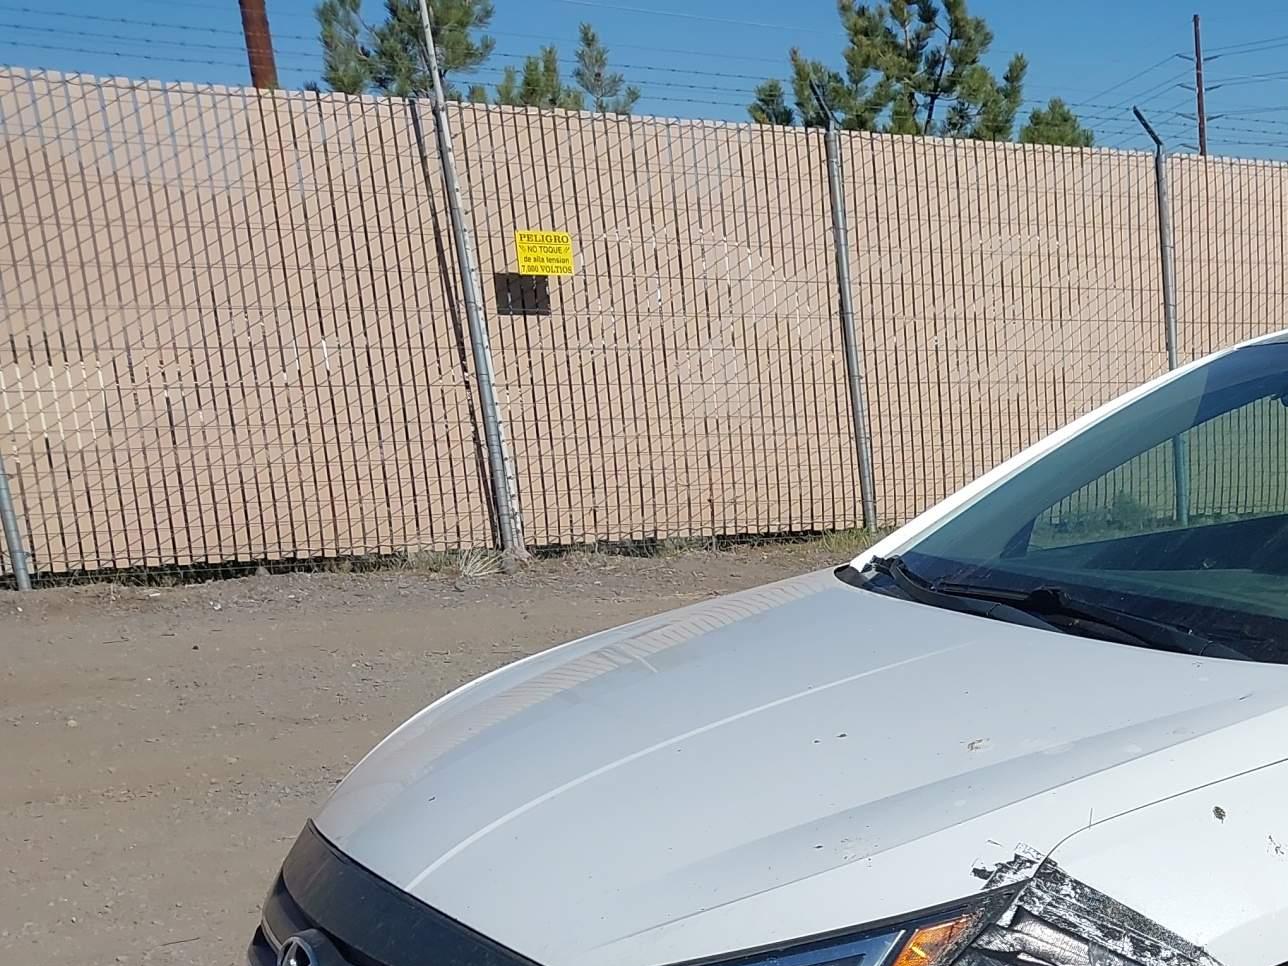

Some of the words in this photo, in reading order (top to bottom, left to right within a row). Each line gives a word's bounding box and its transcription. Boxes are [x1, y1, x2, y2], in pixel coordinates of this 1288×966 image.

[519, 233, 569, 243] PELIGRO
[527, 245, 538, 253] NO
[539, 245, 563, 254] TOQUE
[539, 265, 573, 274] VOLTIOS
